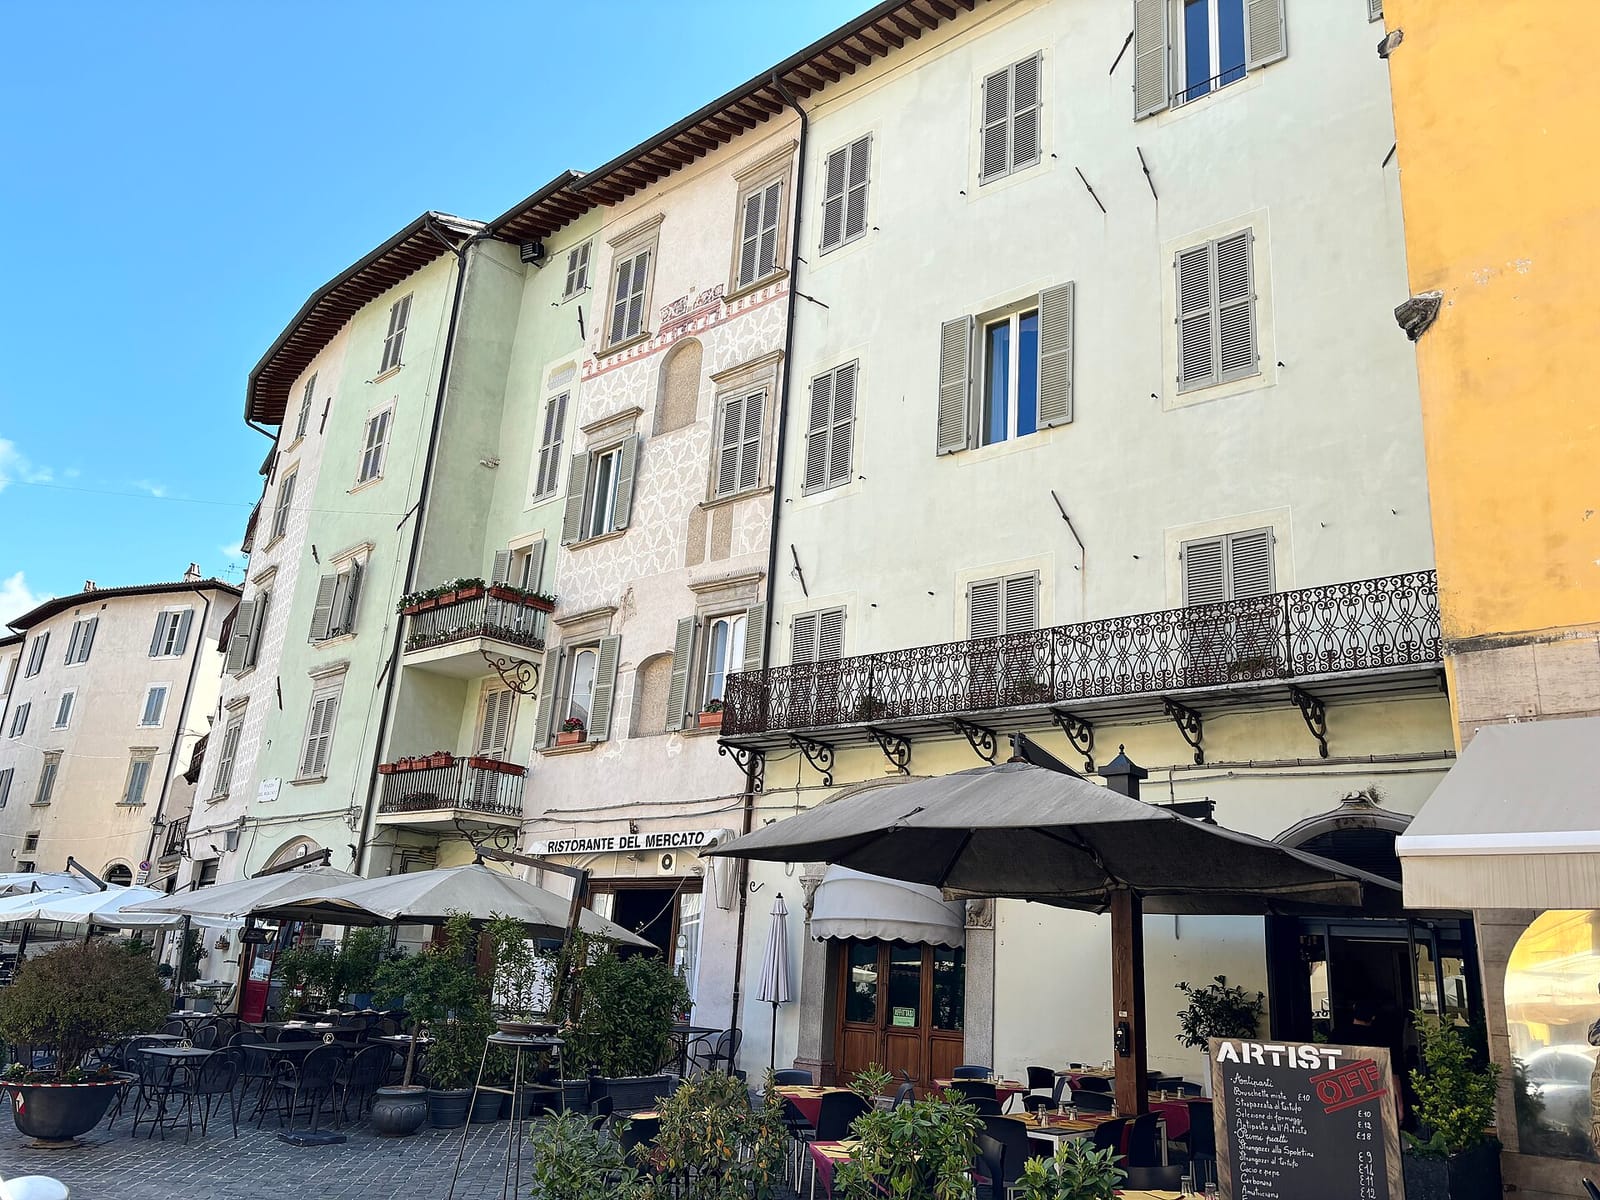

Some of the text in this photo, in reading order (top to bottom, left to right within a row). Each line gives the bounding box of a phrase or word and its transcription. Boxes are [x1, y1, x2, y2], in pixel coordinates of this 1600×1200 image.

[547, 831, 705, 853] RISTORANTE DEL MERCATO
[1216, 1041, 1343, 1070] ARTIST
[1316, 1064, 1381, 1105] OFF
[1264, 1169, 1281, 1177] pepe
